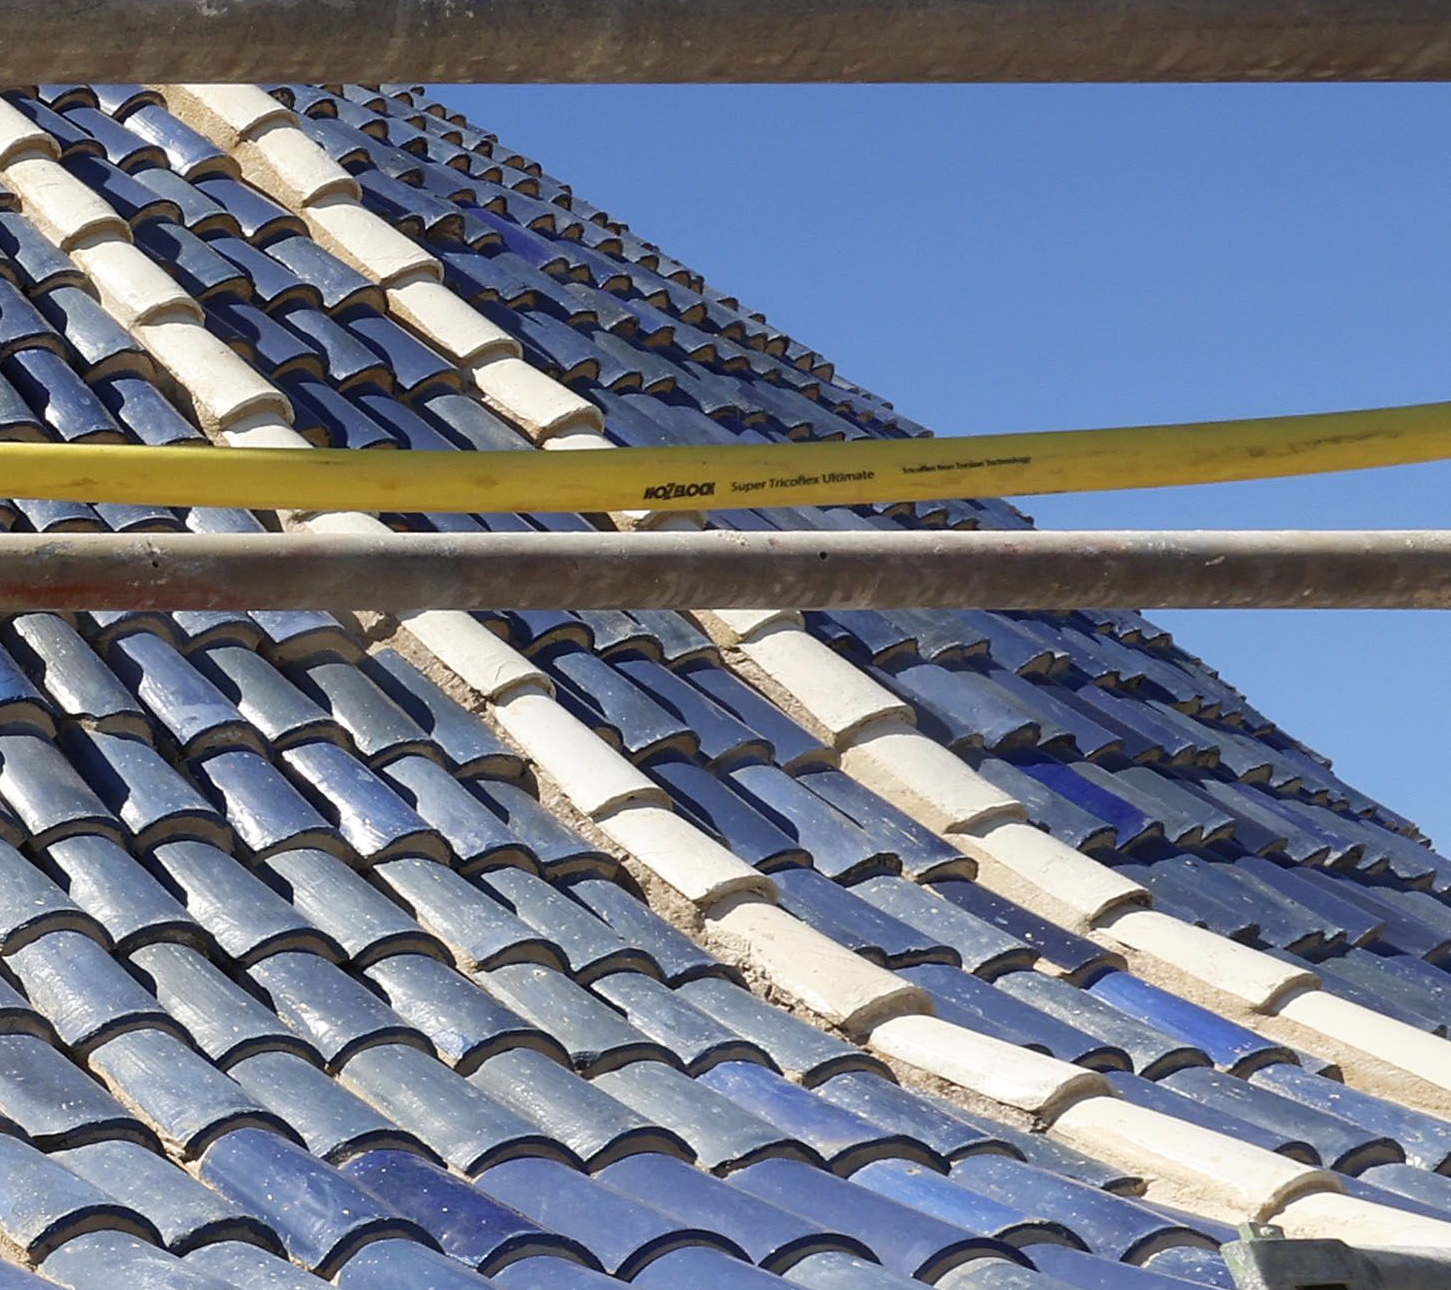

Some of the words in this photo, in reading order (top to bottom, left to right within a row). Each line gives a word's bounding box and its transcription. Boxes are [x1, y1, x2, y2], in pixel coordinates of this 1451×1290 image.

[643, 482, 716, 500] HOZELOCK
[730, 480, 766, 493] Super
[769, 475, 819, 489] Tricoflex
[822, 470, 875, 484] Ultimate
